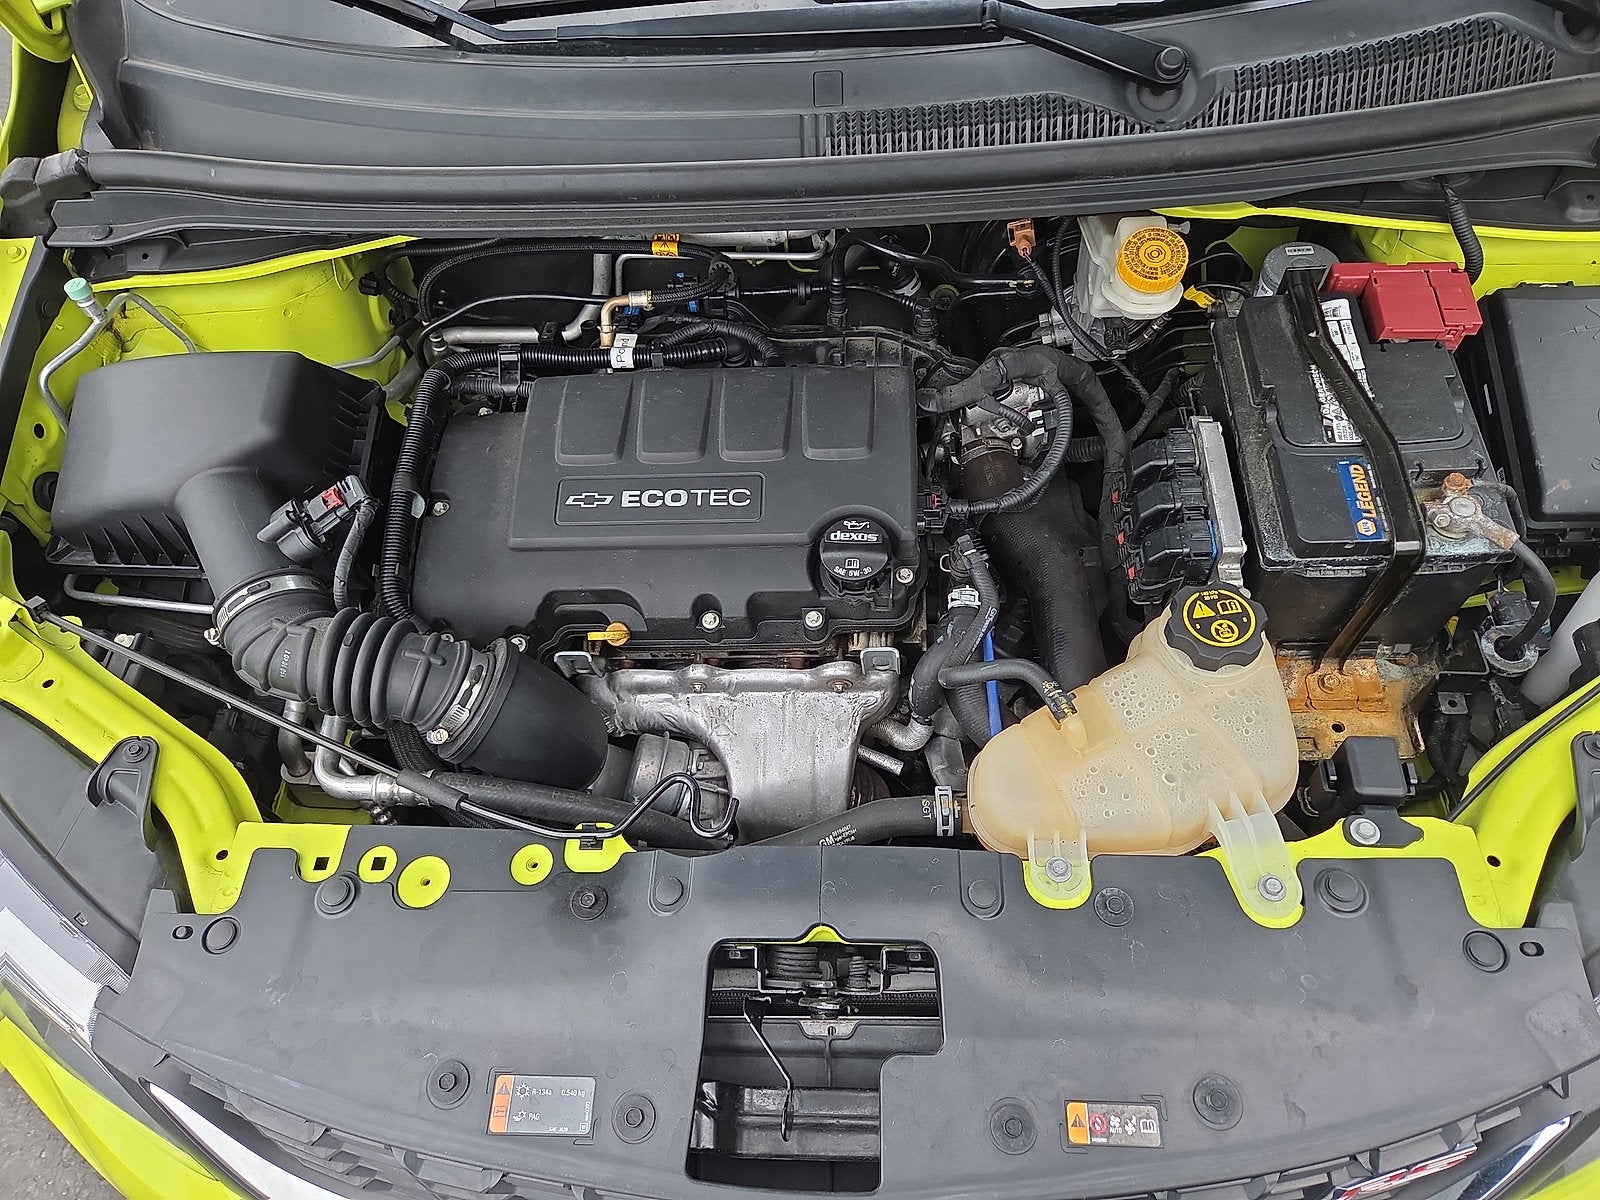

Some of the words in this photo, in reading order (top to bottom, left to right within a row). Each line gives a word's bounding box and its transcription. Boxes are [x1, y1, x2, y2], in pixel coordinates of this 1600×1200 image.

[1349, 464, 1377, 518] LEGEND
[621, 488, 751, 508] ECOTEC
[830, 530, 879, 542] dexos
[833, 565, 847, 576] SAE
[848, 566, 872, 577] 5W-30
[921, 799, 932, 820] SGT
[818, 834, 835, 846] GM
[528, 1112, 540, 1121] PAG
